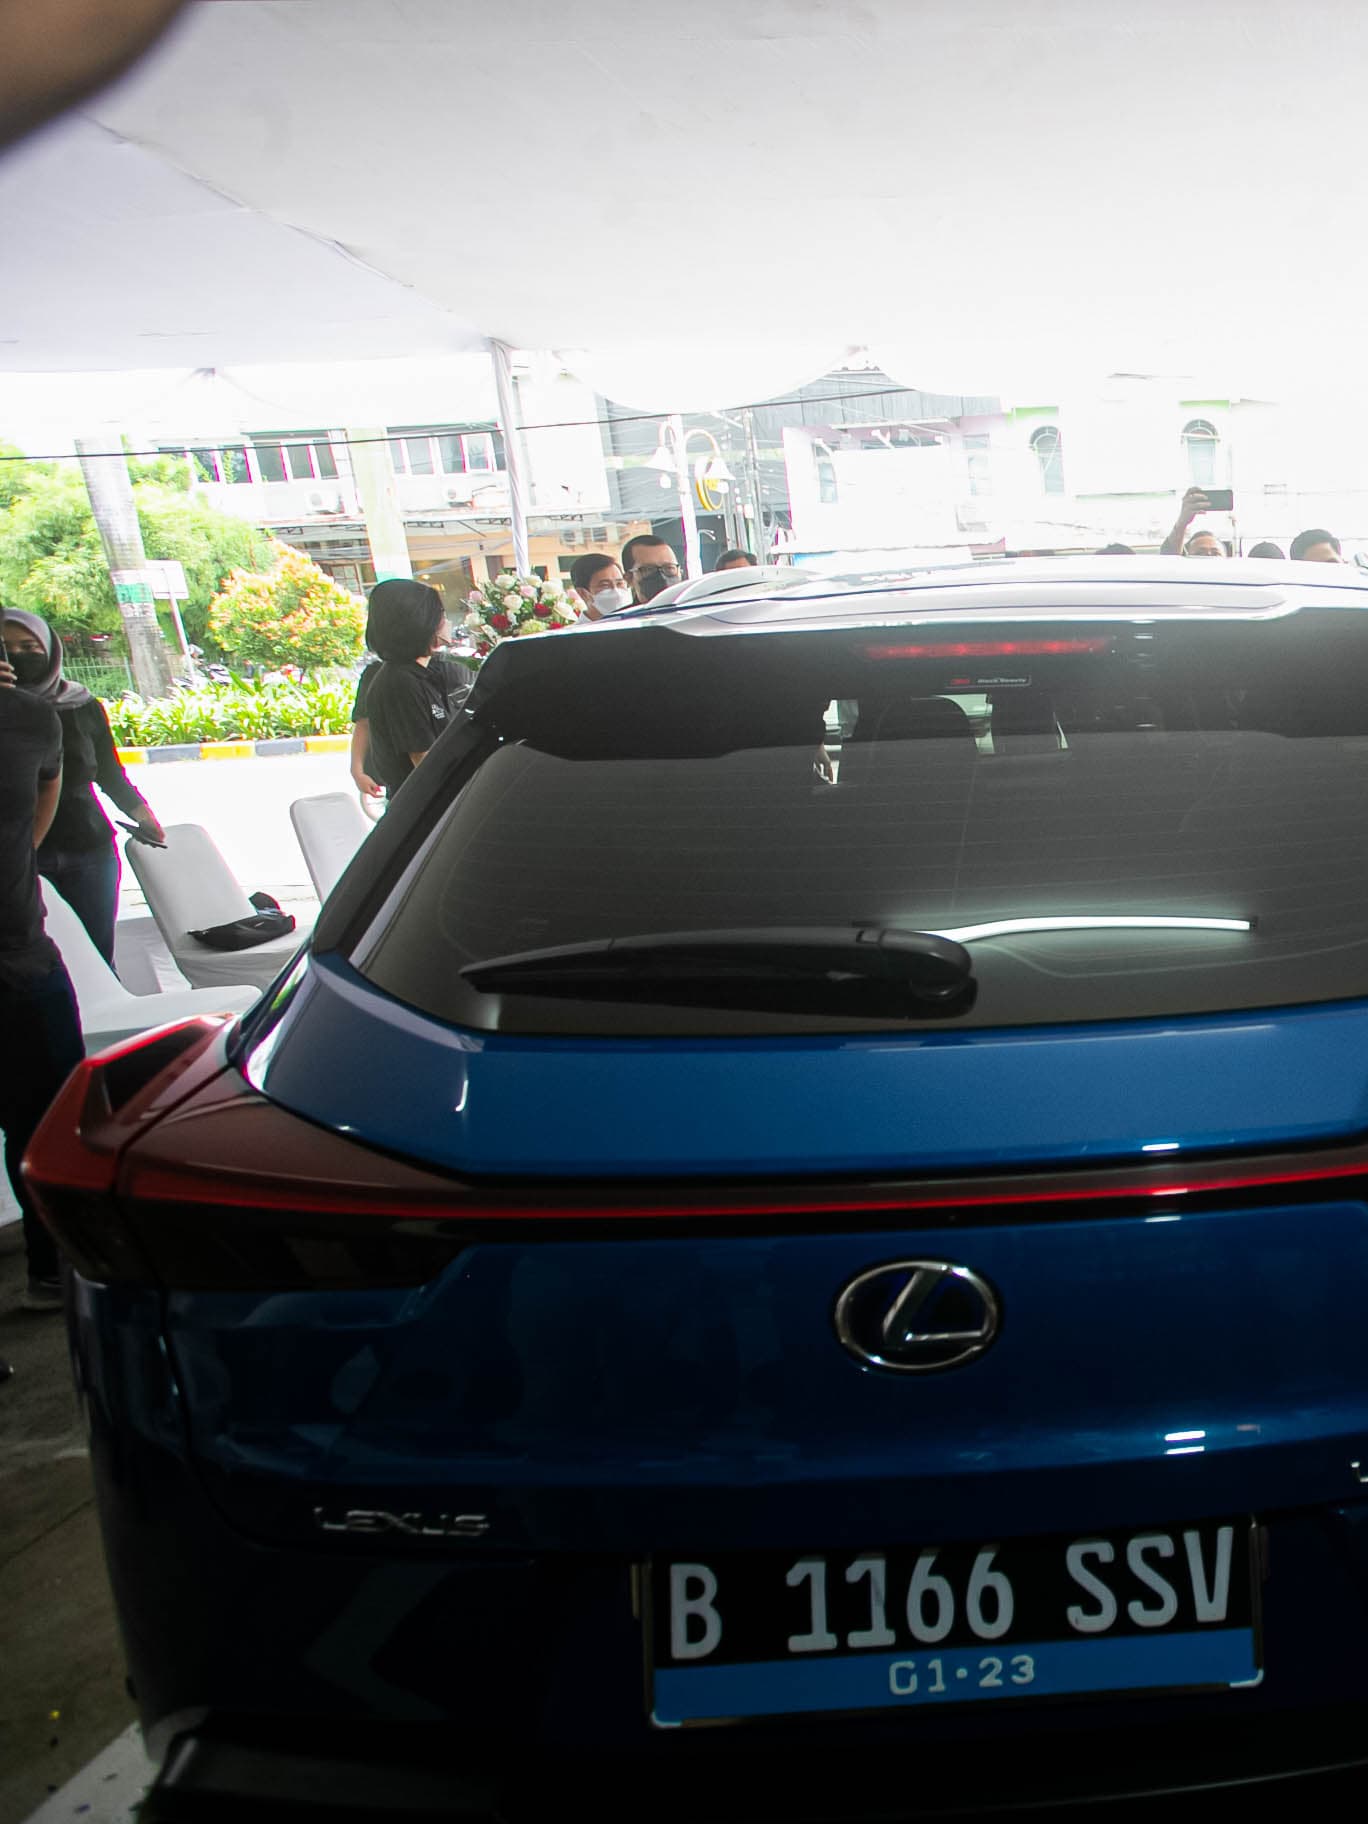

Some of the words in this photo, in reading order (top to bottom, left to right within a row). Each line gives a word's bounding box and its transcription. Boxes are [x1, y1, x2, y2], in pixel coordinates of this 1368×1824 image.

[313, 1507, 491, 1537] LEXUS
[670, 1562, 722, 1660] B
[785, 1550, 1014, 1653] 1166
[1065, 1526, 1234, 1633] SSV
